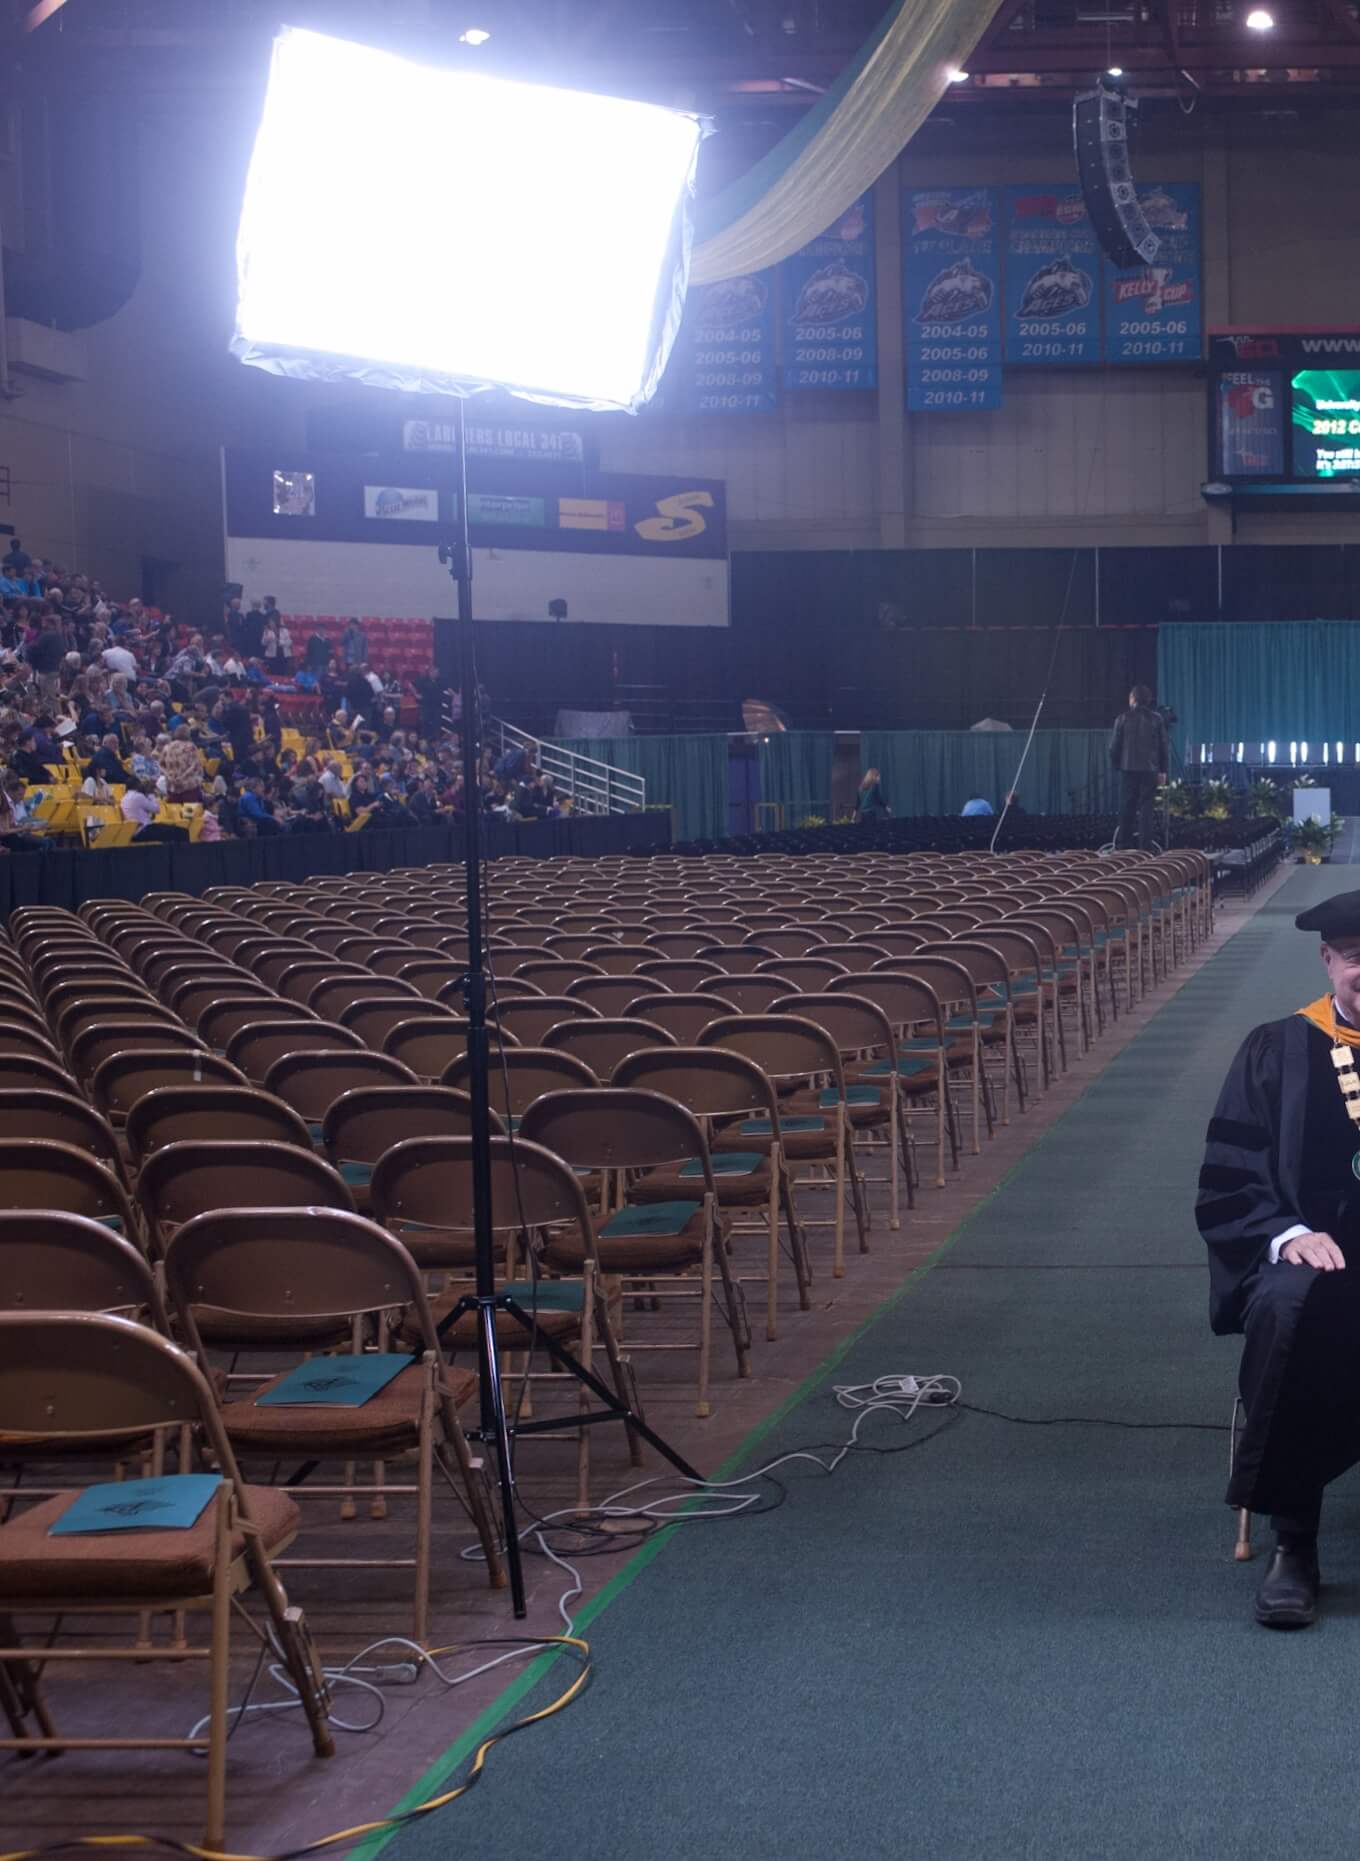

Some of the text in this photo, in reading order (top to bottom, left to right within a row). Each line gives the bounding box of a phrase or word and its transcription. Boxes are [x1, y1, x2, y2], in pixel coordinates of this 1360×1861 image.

[1119, 281, 1188, 301] KELLY CUP
[795, 326, 863, 341] 2005-06
[921, 325, 988, 339] 2004-05
[1019, 322, 1087, 336] 2005-06
[1120, 321, 1187, 335] 2005-06
[795, 347, 863, 361] 2008-09
[921, 346, 988, 361] 2005-06
[1022, 343, 1084, 356] 2010-11
[1122, 342, 1184, 355] 2010-11
[695, 351, 761, 365] 2005-06
[799, 369, 859, 384] 2010-11
[921, 368, 989, 383] 2008-09
[699, 394, 761, 409] 2010-11
[924, 391, 985, 405] 2010-11
[1315, 399, 1360, 412] University
[1312, 419, 1347, 434] 2012
[497, 429, 536, 449] LOCAL
[1316, 449, 1335, 459] You
